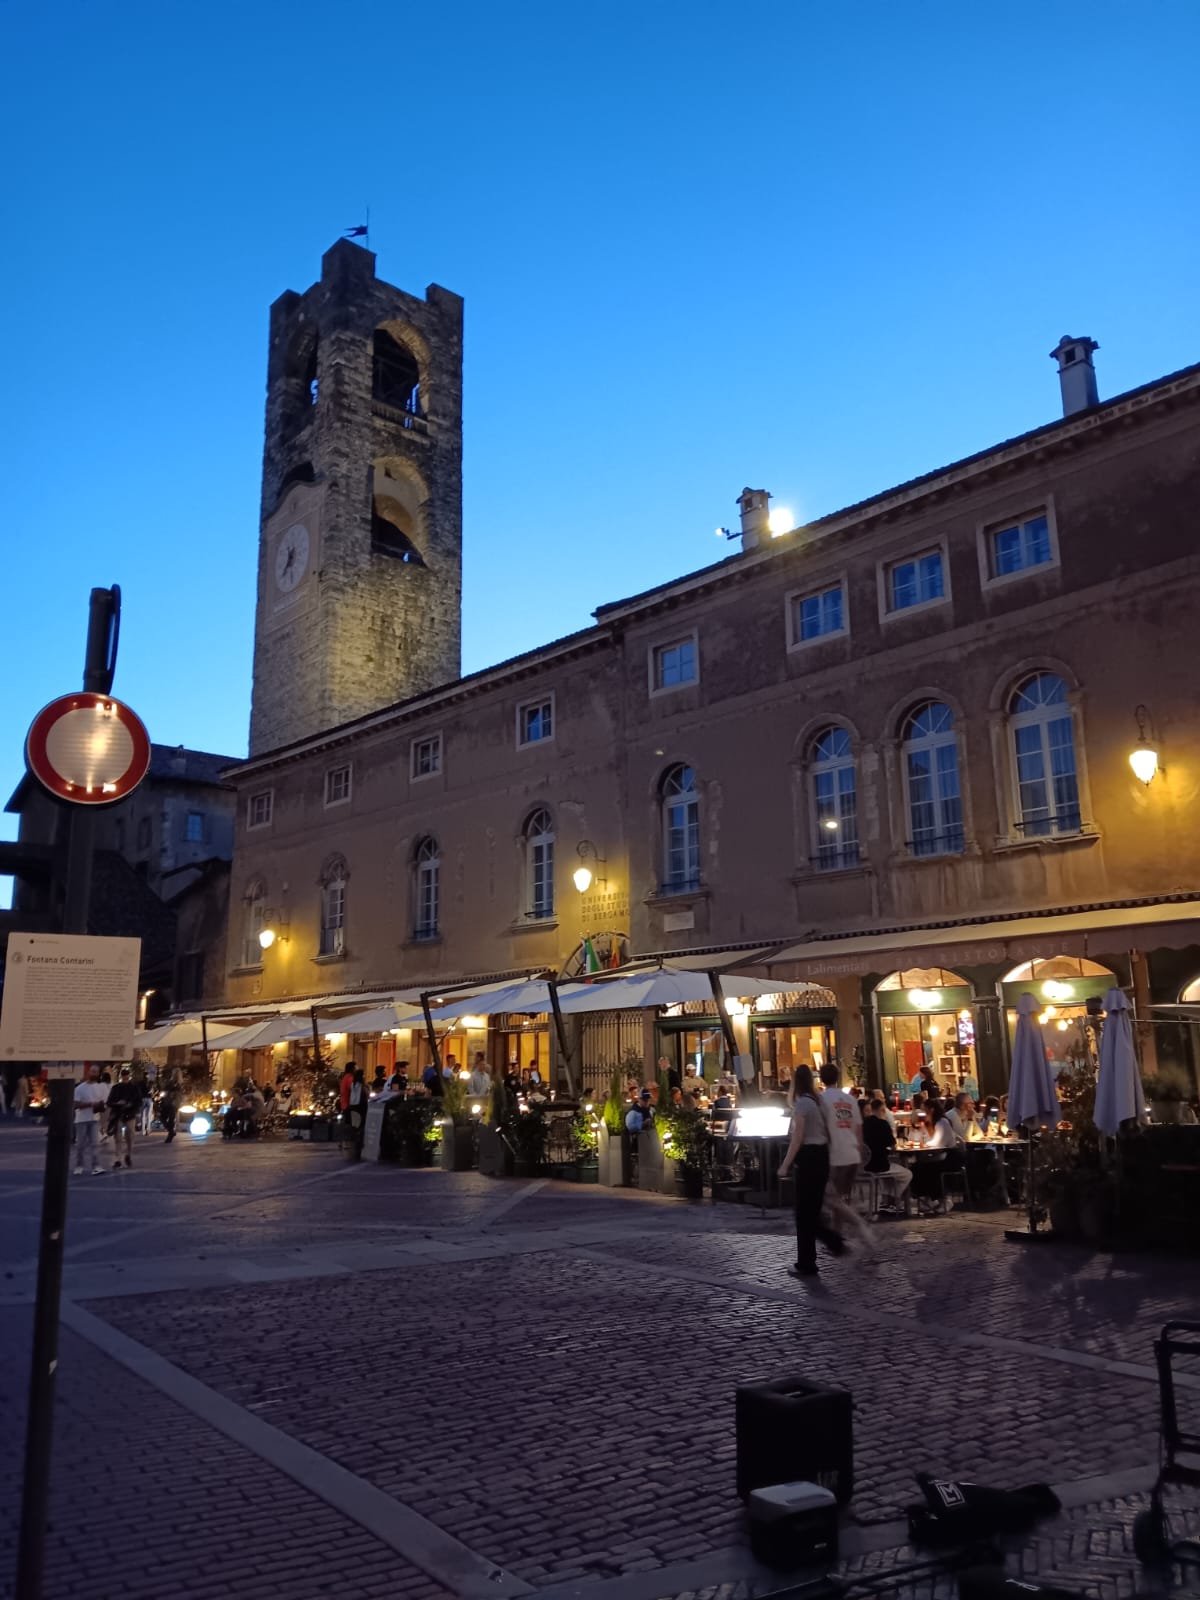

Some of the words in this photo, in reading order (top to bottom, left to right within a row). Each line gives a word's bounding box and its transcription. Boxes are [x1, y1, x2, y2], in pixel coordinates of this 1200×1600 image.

[581, 892, 628, 905] UNIVERSIT
[607, 900, 628, 910] STUD
[27, 956, 58, 964] Fontana
[60, 956, 94, 965] Contarini
